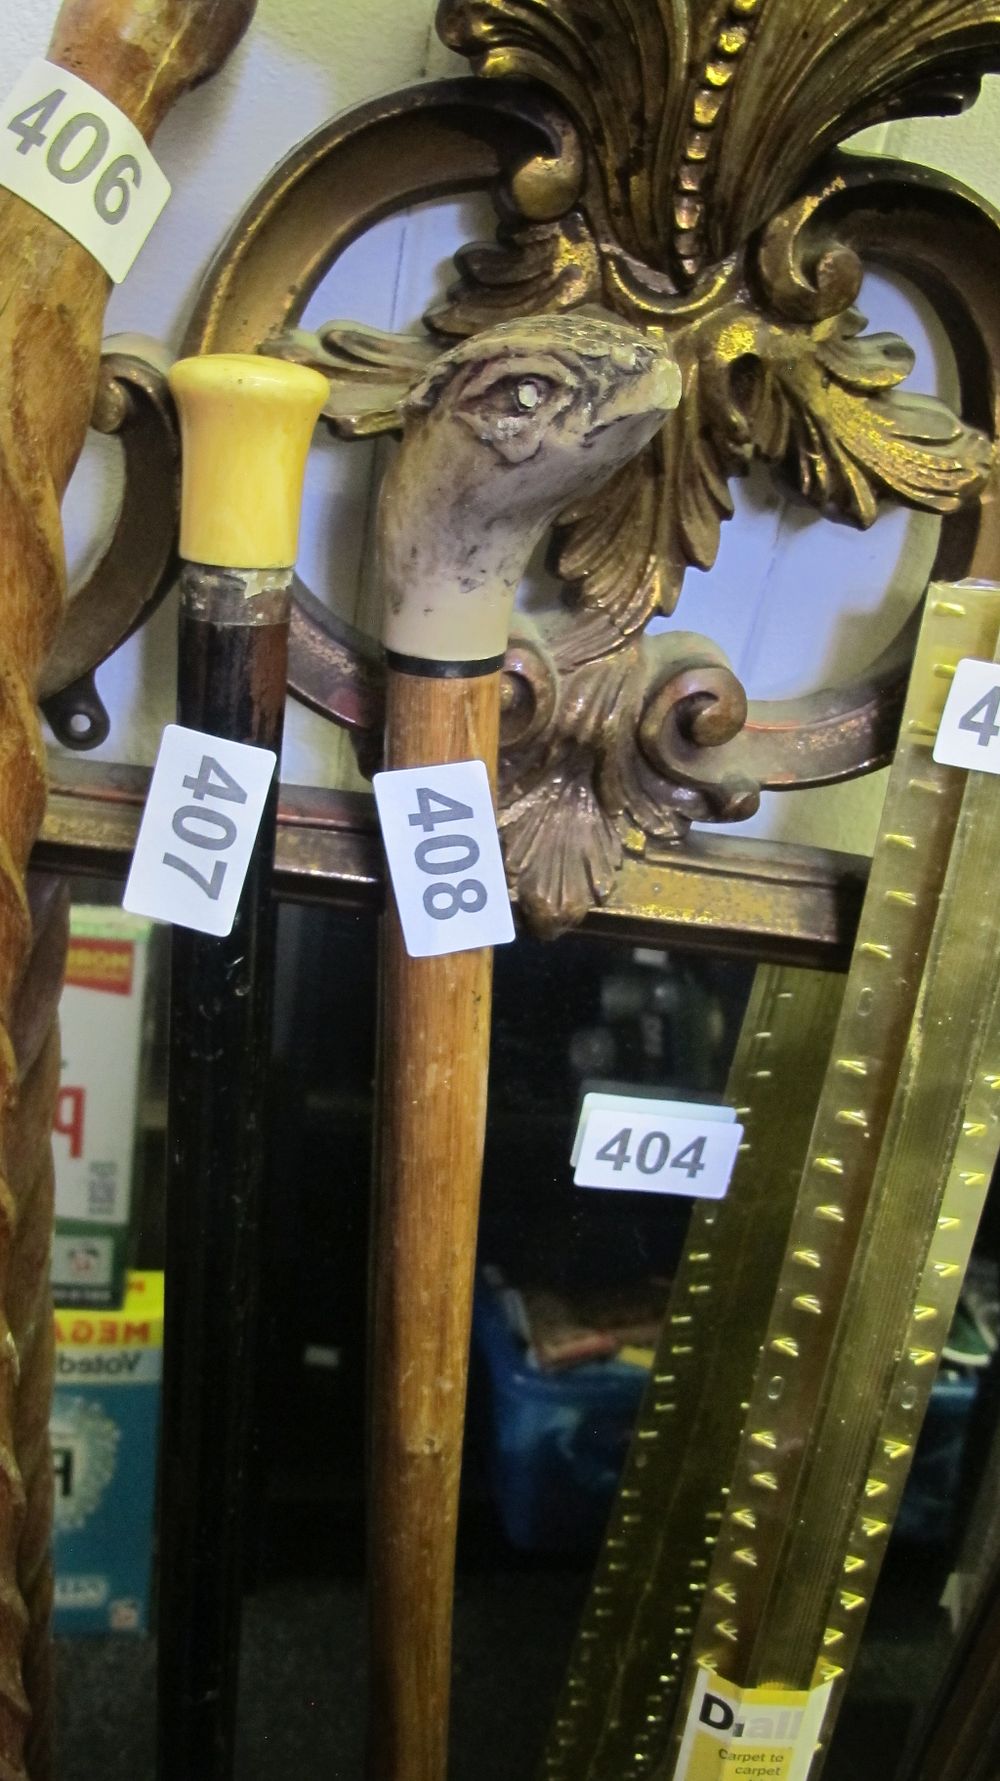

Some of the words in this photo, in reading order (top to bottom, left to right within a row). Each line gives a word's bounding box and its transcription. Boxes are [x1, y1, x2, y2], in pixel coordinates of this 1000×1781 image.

[7, 88, 142, 226] 406
[162, 755, 248, 901] 407
[408, 787, 488, 920] 408
[595, 1128, 708, 1179] 404
[718, 1748, 766, 1763] Carpet
[769, 1753, 784, 1763] to
[735, 1766, 781, 1776] carpet
